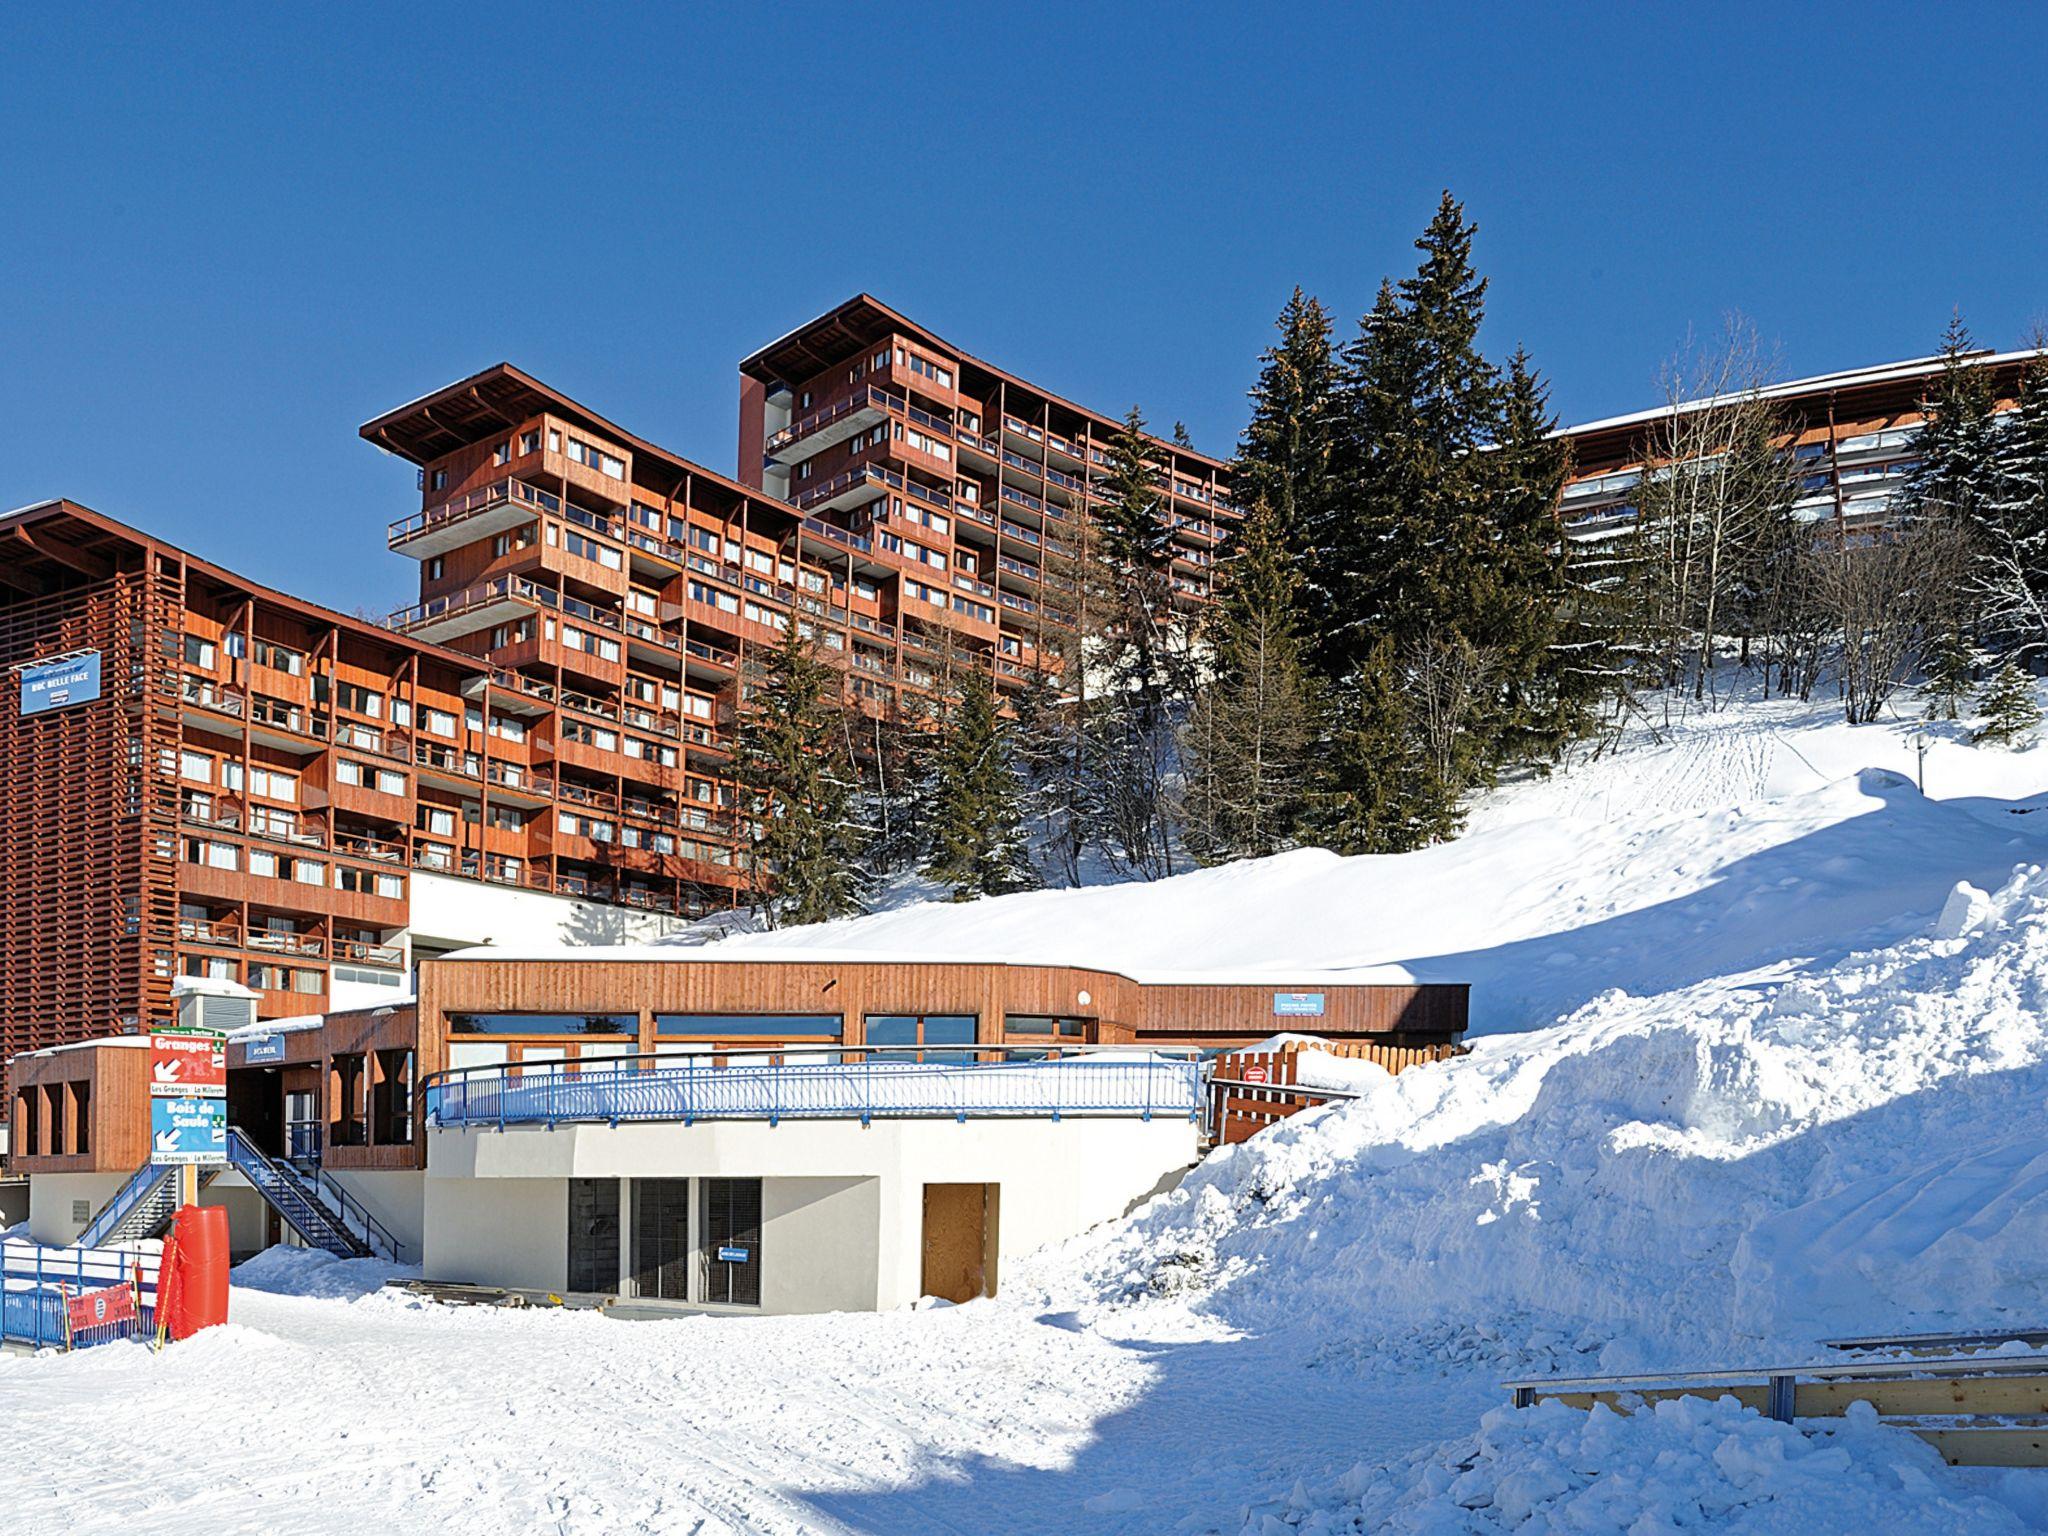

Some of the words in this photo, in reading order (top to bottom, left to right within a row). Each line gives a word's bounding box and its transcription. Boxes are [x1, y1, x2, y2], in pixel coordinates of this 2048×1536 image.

[47, 676, 70, 688] BELLE
[71, 672, 89, 684] FACE
[155, 1037, 210, 1053] Granges
[163, 1085, 188, 1094] Granges
[166, 1100, 196, 1114] Bois
[198, 1101, 215, 1114] de
[172, 1114, 209, 1128] Saule
[163, 1154, 188, 1163] Granges
